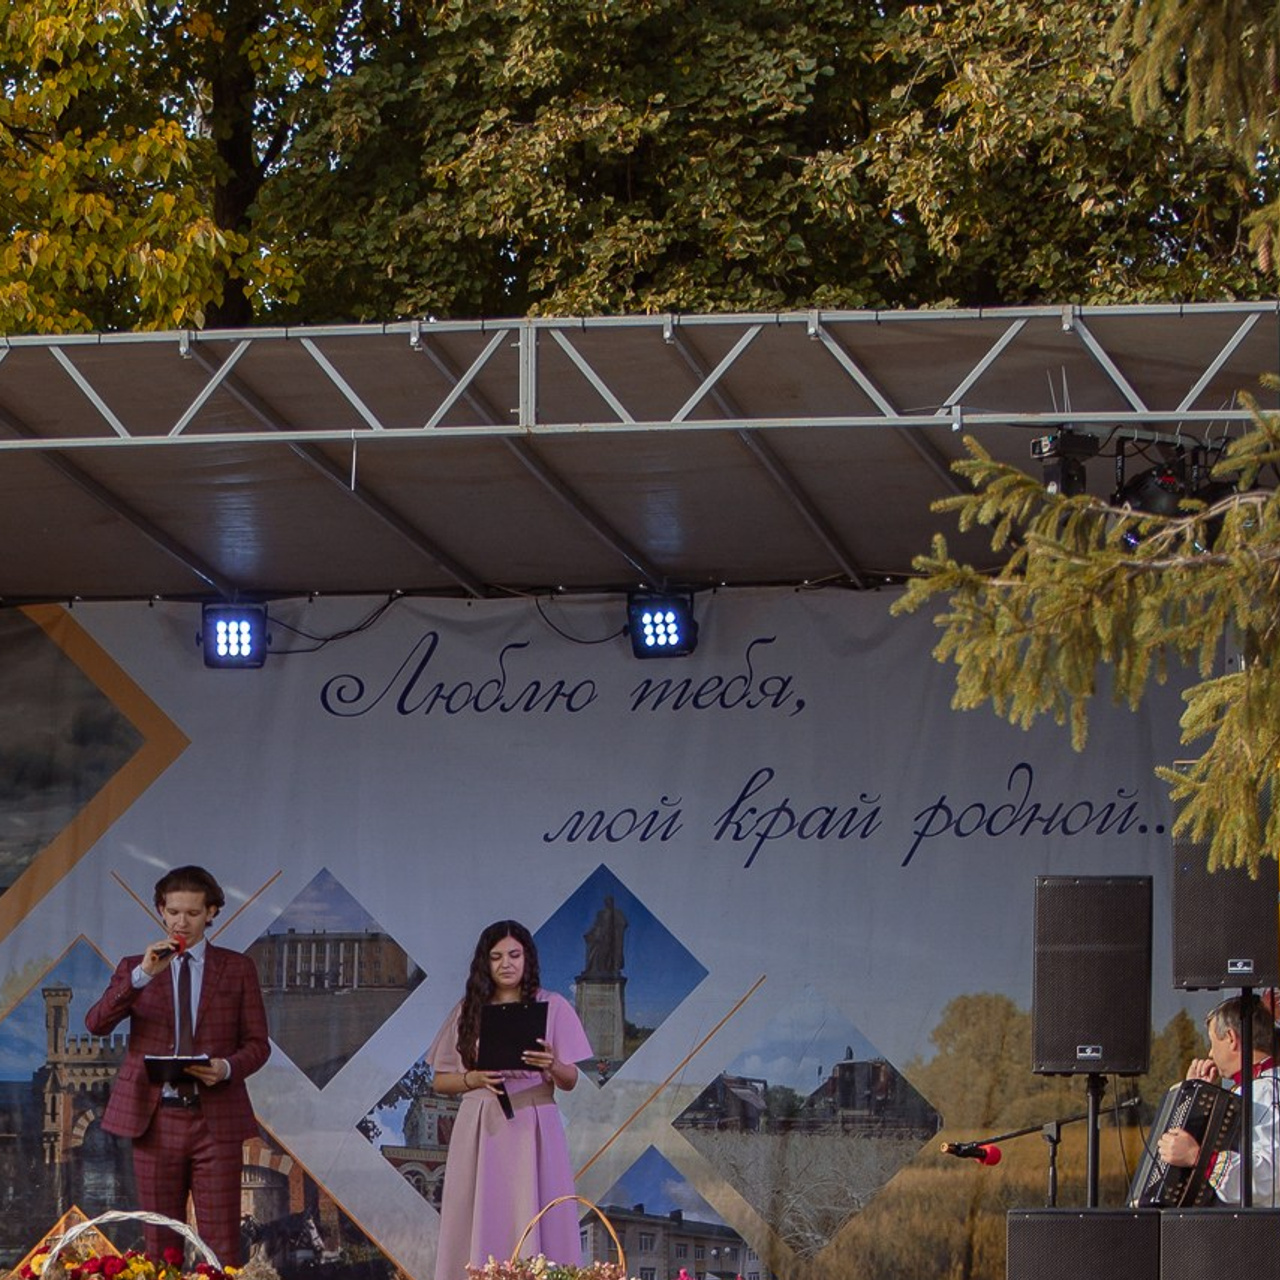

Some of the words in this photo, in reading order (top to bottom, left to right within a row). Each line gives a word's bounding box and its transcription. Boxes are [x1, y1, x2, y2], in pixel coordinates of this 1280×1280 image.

[320, 630, 599, 717] Люблю
[630, 635, 806, 717] тебя,
[543, 796, 683, 843] мой
[714, 766, 883, 869] край
